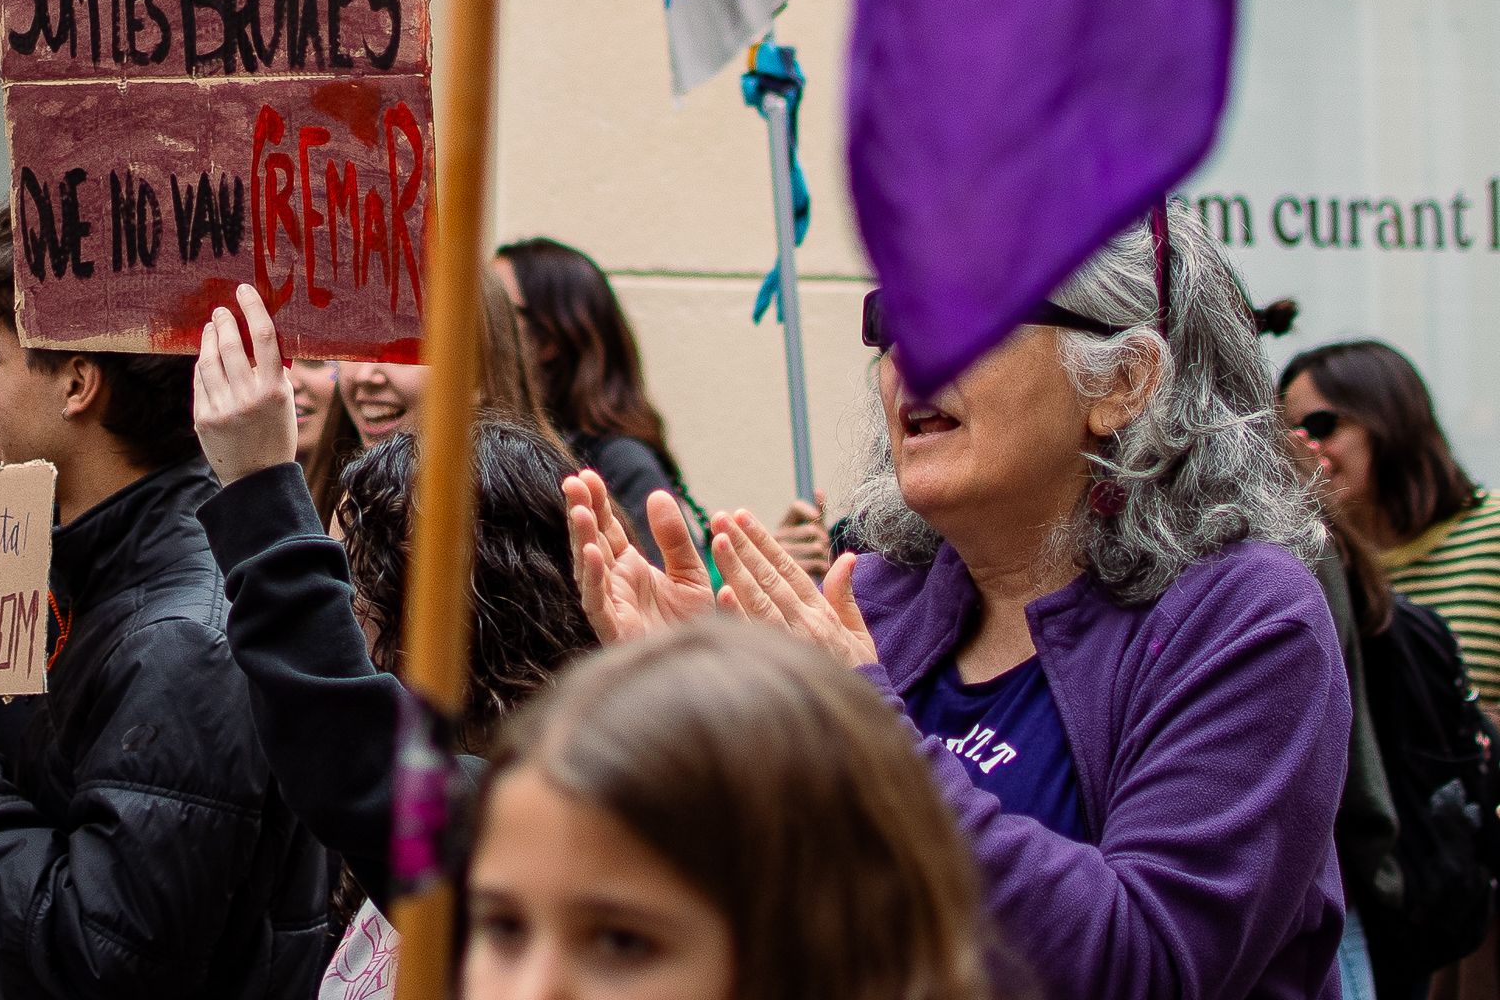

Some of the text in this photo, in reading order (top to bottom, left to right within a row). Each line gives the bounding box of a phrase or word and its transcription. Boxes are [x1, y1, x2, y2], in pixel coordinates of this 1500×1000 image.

[19, 166, 94, 283] QUE
[110, 168, 163, 273] NO
[251, 101, 425, 322] CREMAR
[1271, 192, 1475, 251] curant
